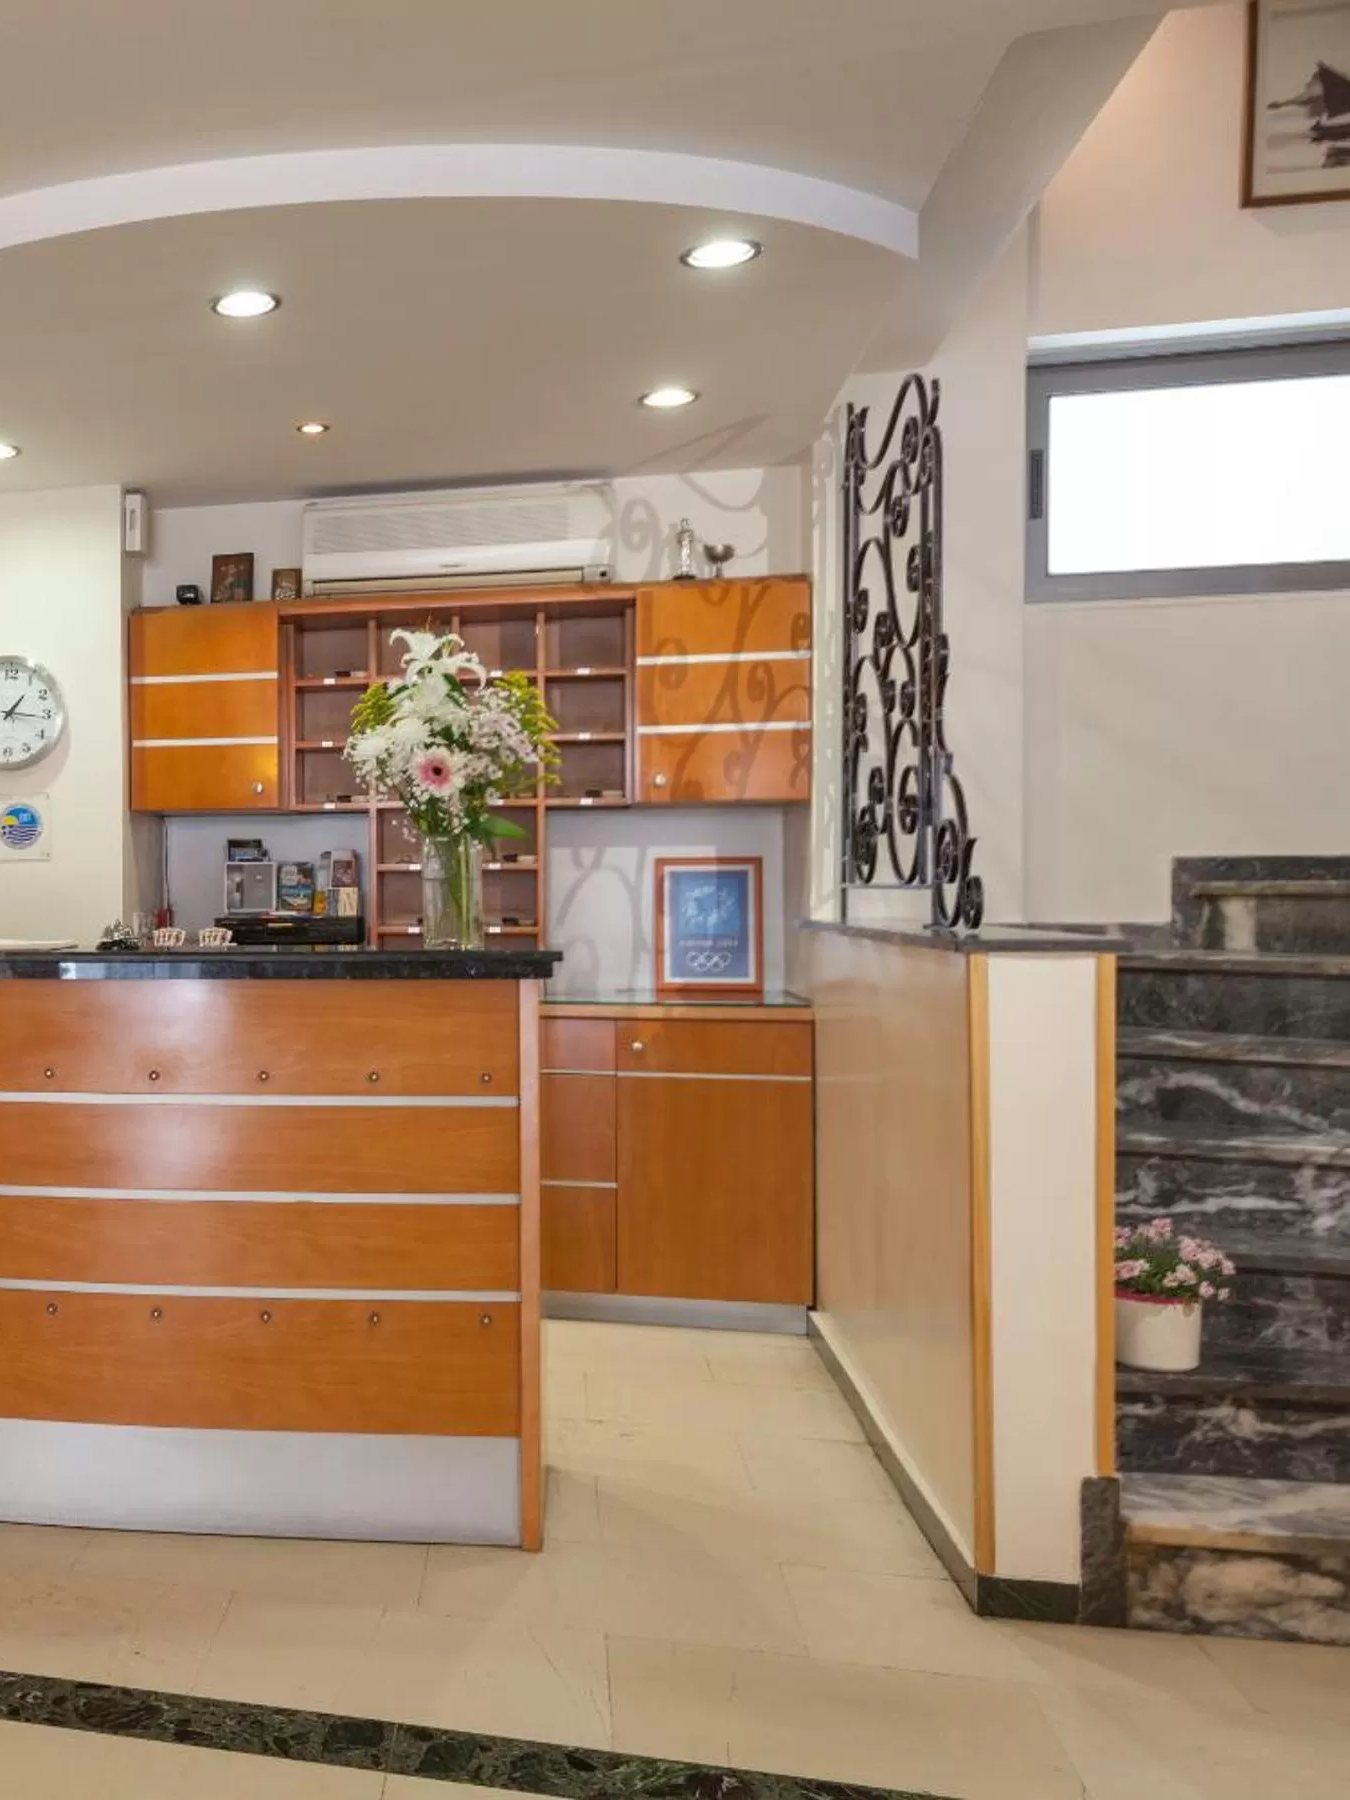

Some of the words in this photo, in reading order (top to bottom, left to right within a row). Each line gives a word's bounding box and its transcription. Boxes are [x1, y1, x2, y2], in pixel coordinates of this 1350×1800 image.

[5, 668, 19, 680] 12
[38, 688, 48, 700] 2
[42, 708, 52, 720] 3
[35, 729, 45, 740] 4
[3, 746, 13, 757] 6
[22, 742, 31, 753] 5
